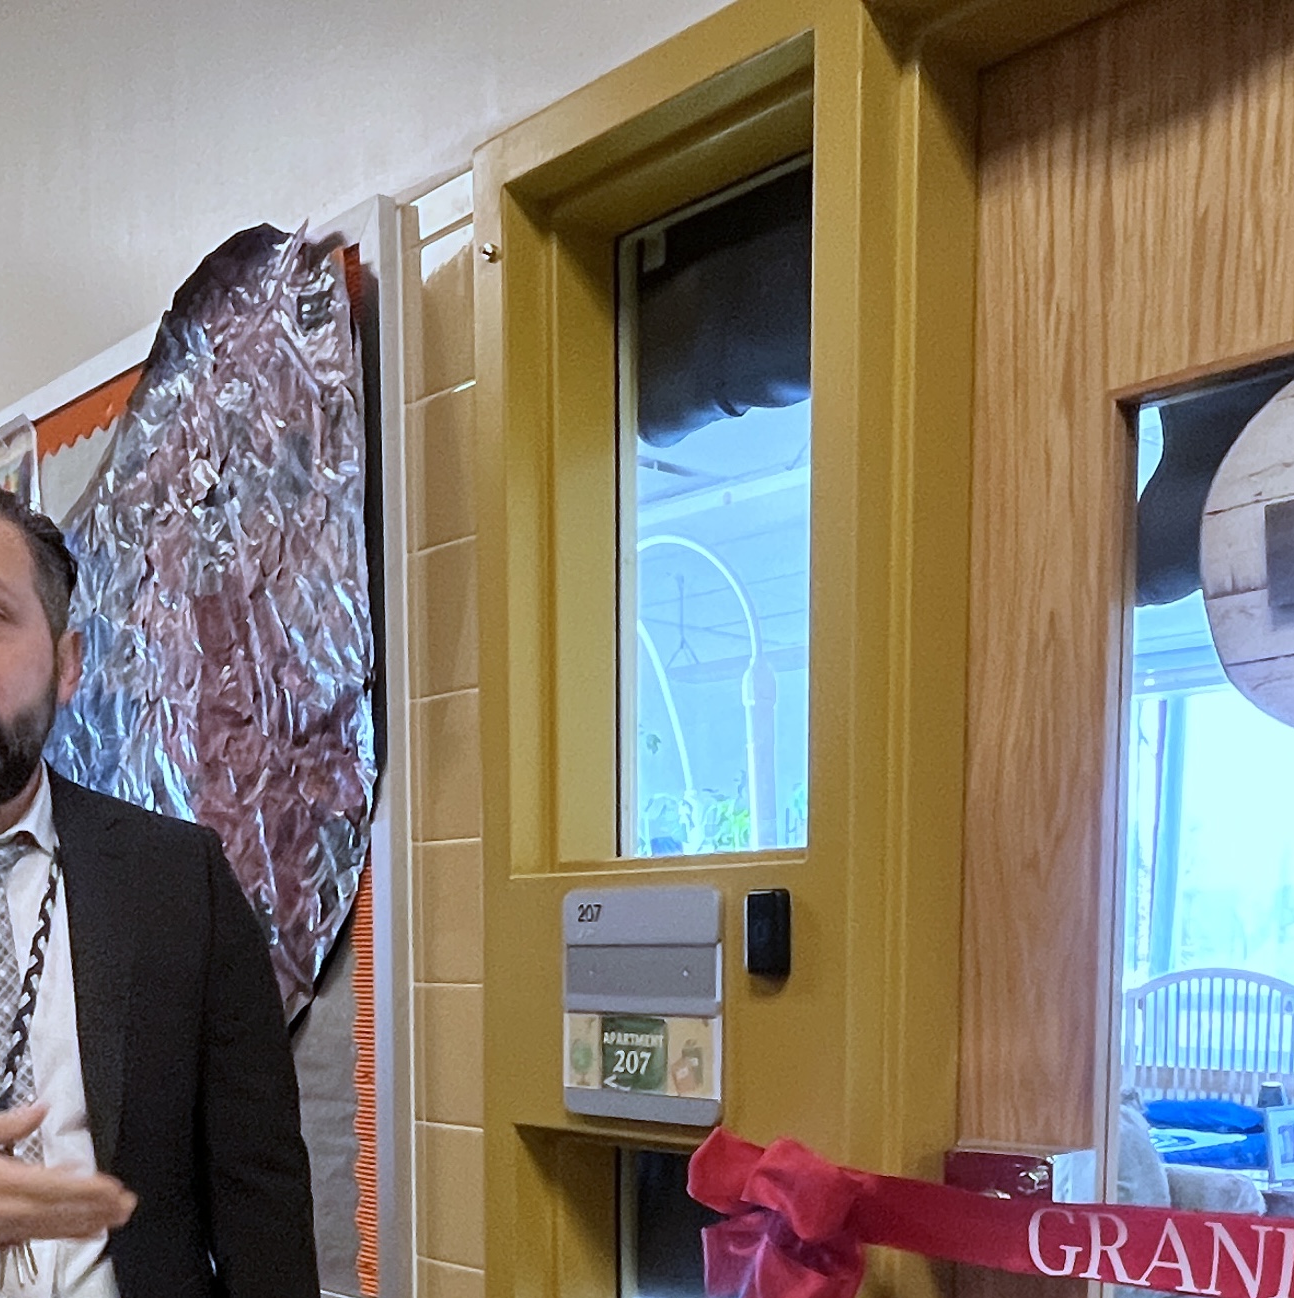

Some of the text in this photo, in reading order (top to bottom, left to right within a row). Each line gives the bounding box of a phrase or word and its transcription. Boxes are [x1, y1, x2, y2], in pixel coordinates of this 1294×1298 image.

[577, 903, 602, 922] 207
[603, 1031, 664, 1048] APARTMENT
[612, 1049, 652, 1075] 207
